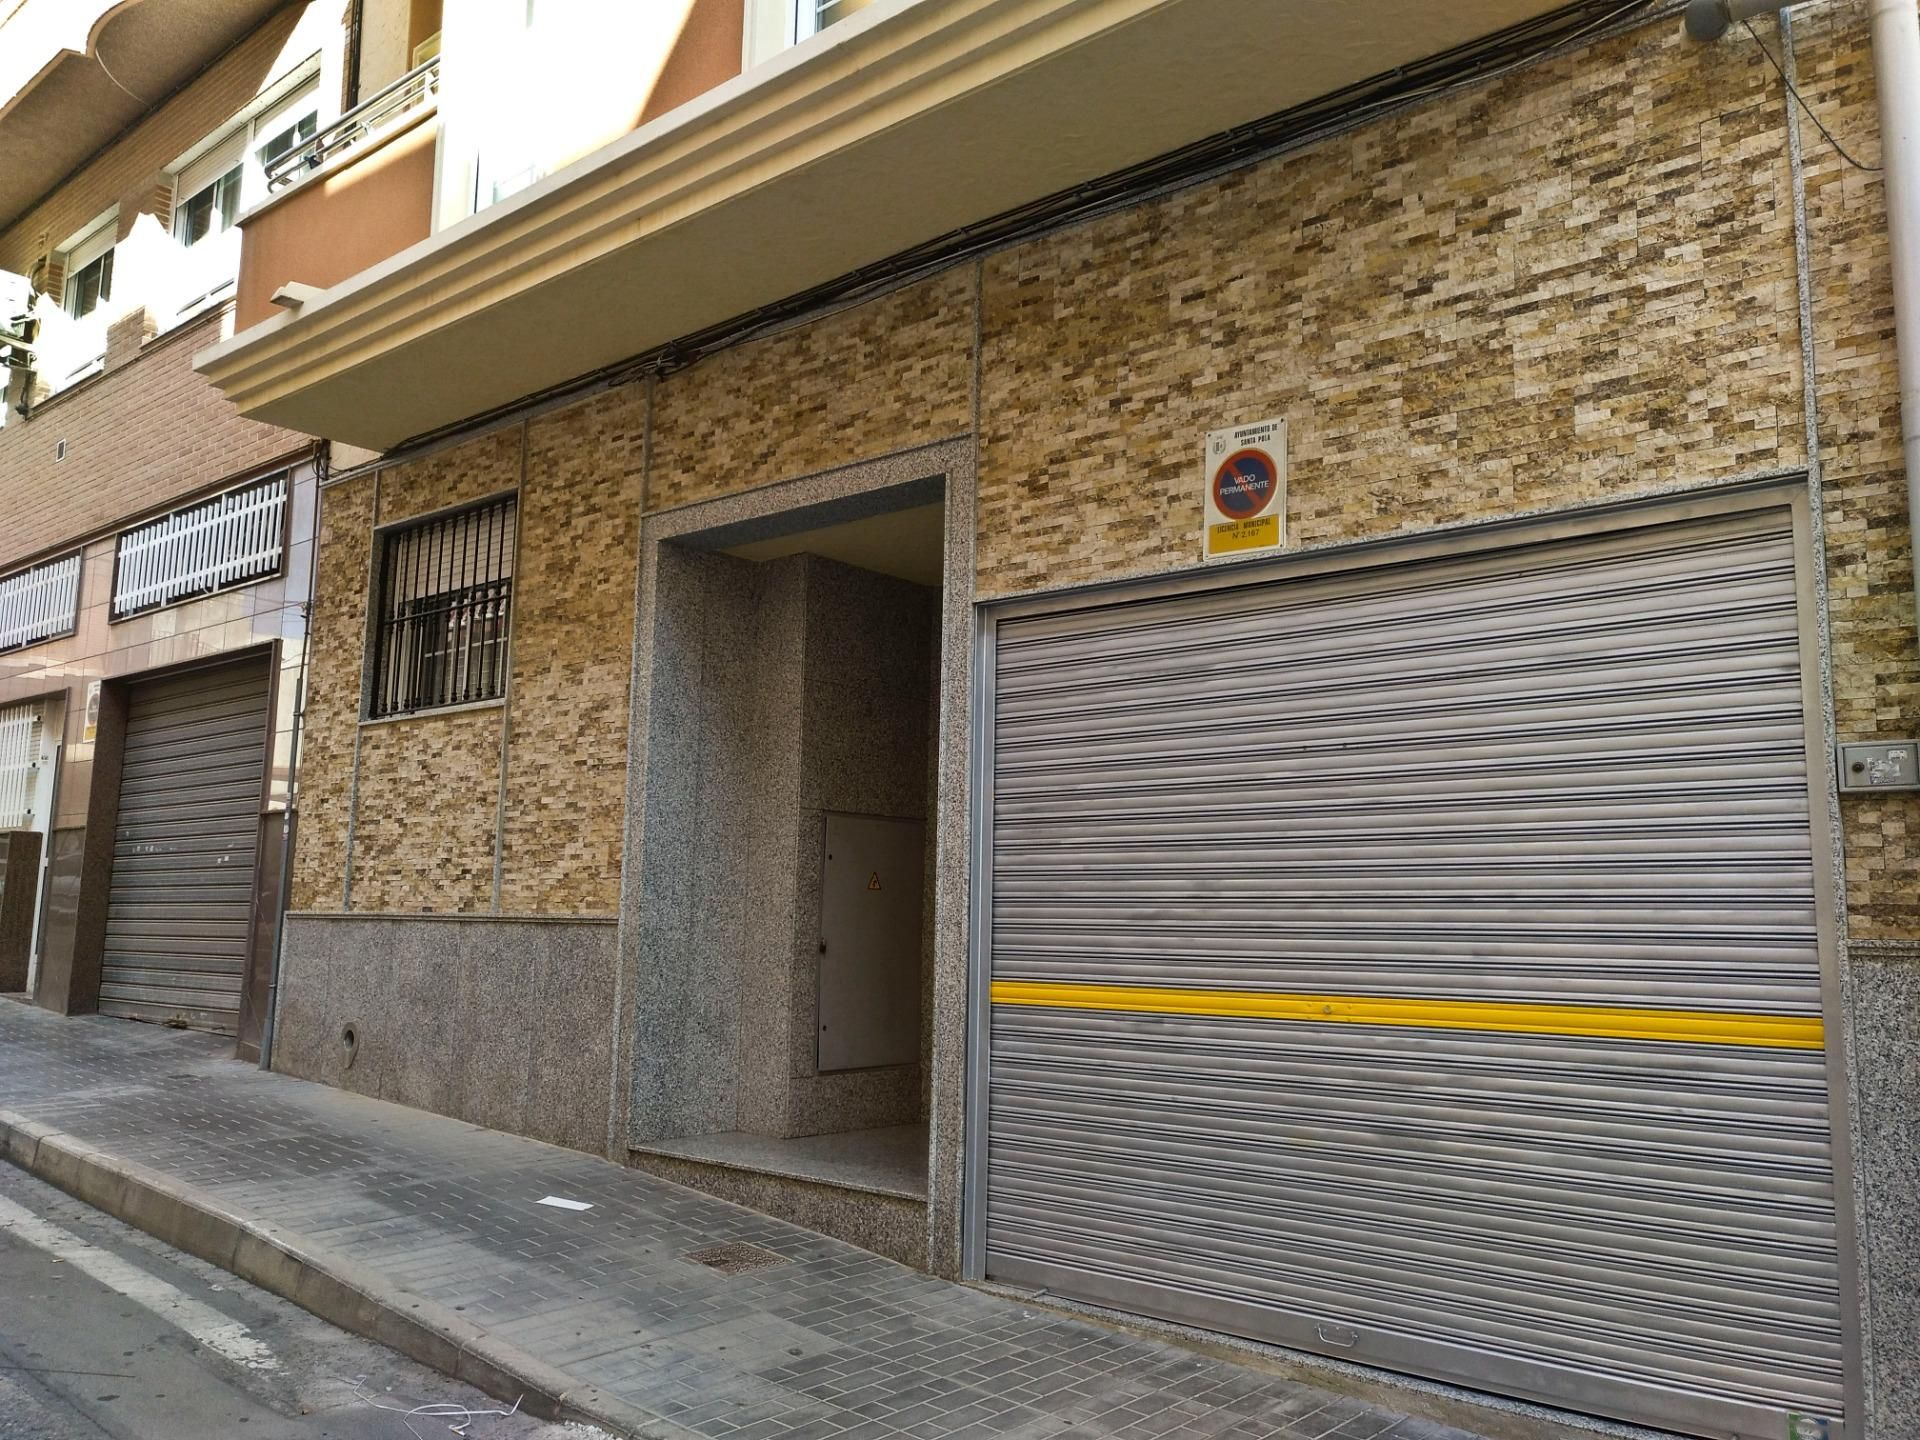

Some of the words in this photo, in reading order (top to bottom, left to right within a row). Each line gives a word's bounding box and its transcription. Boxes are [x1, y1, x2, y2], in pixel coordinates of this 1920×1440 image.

[1234, 424, 1270, 439] AYUNTAMIENTO
[1271, 423, 1278, 431] DE
[1240, 438, 1256, 447] SANTA
[1258, 434, 1271, 443] POLA
[1233, 473, 1256, 485] VADO
[1219, 479, 1270, 497] PERMANENTE
[1217, 522, 1239, 534] LICENCIA
[1243, 517, 1271, 529] MUNICIPAL
